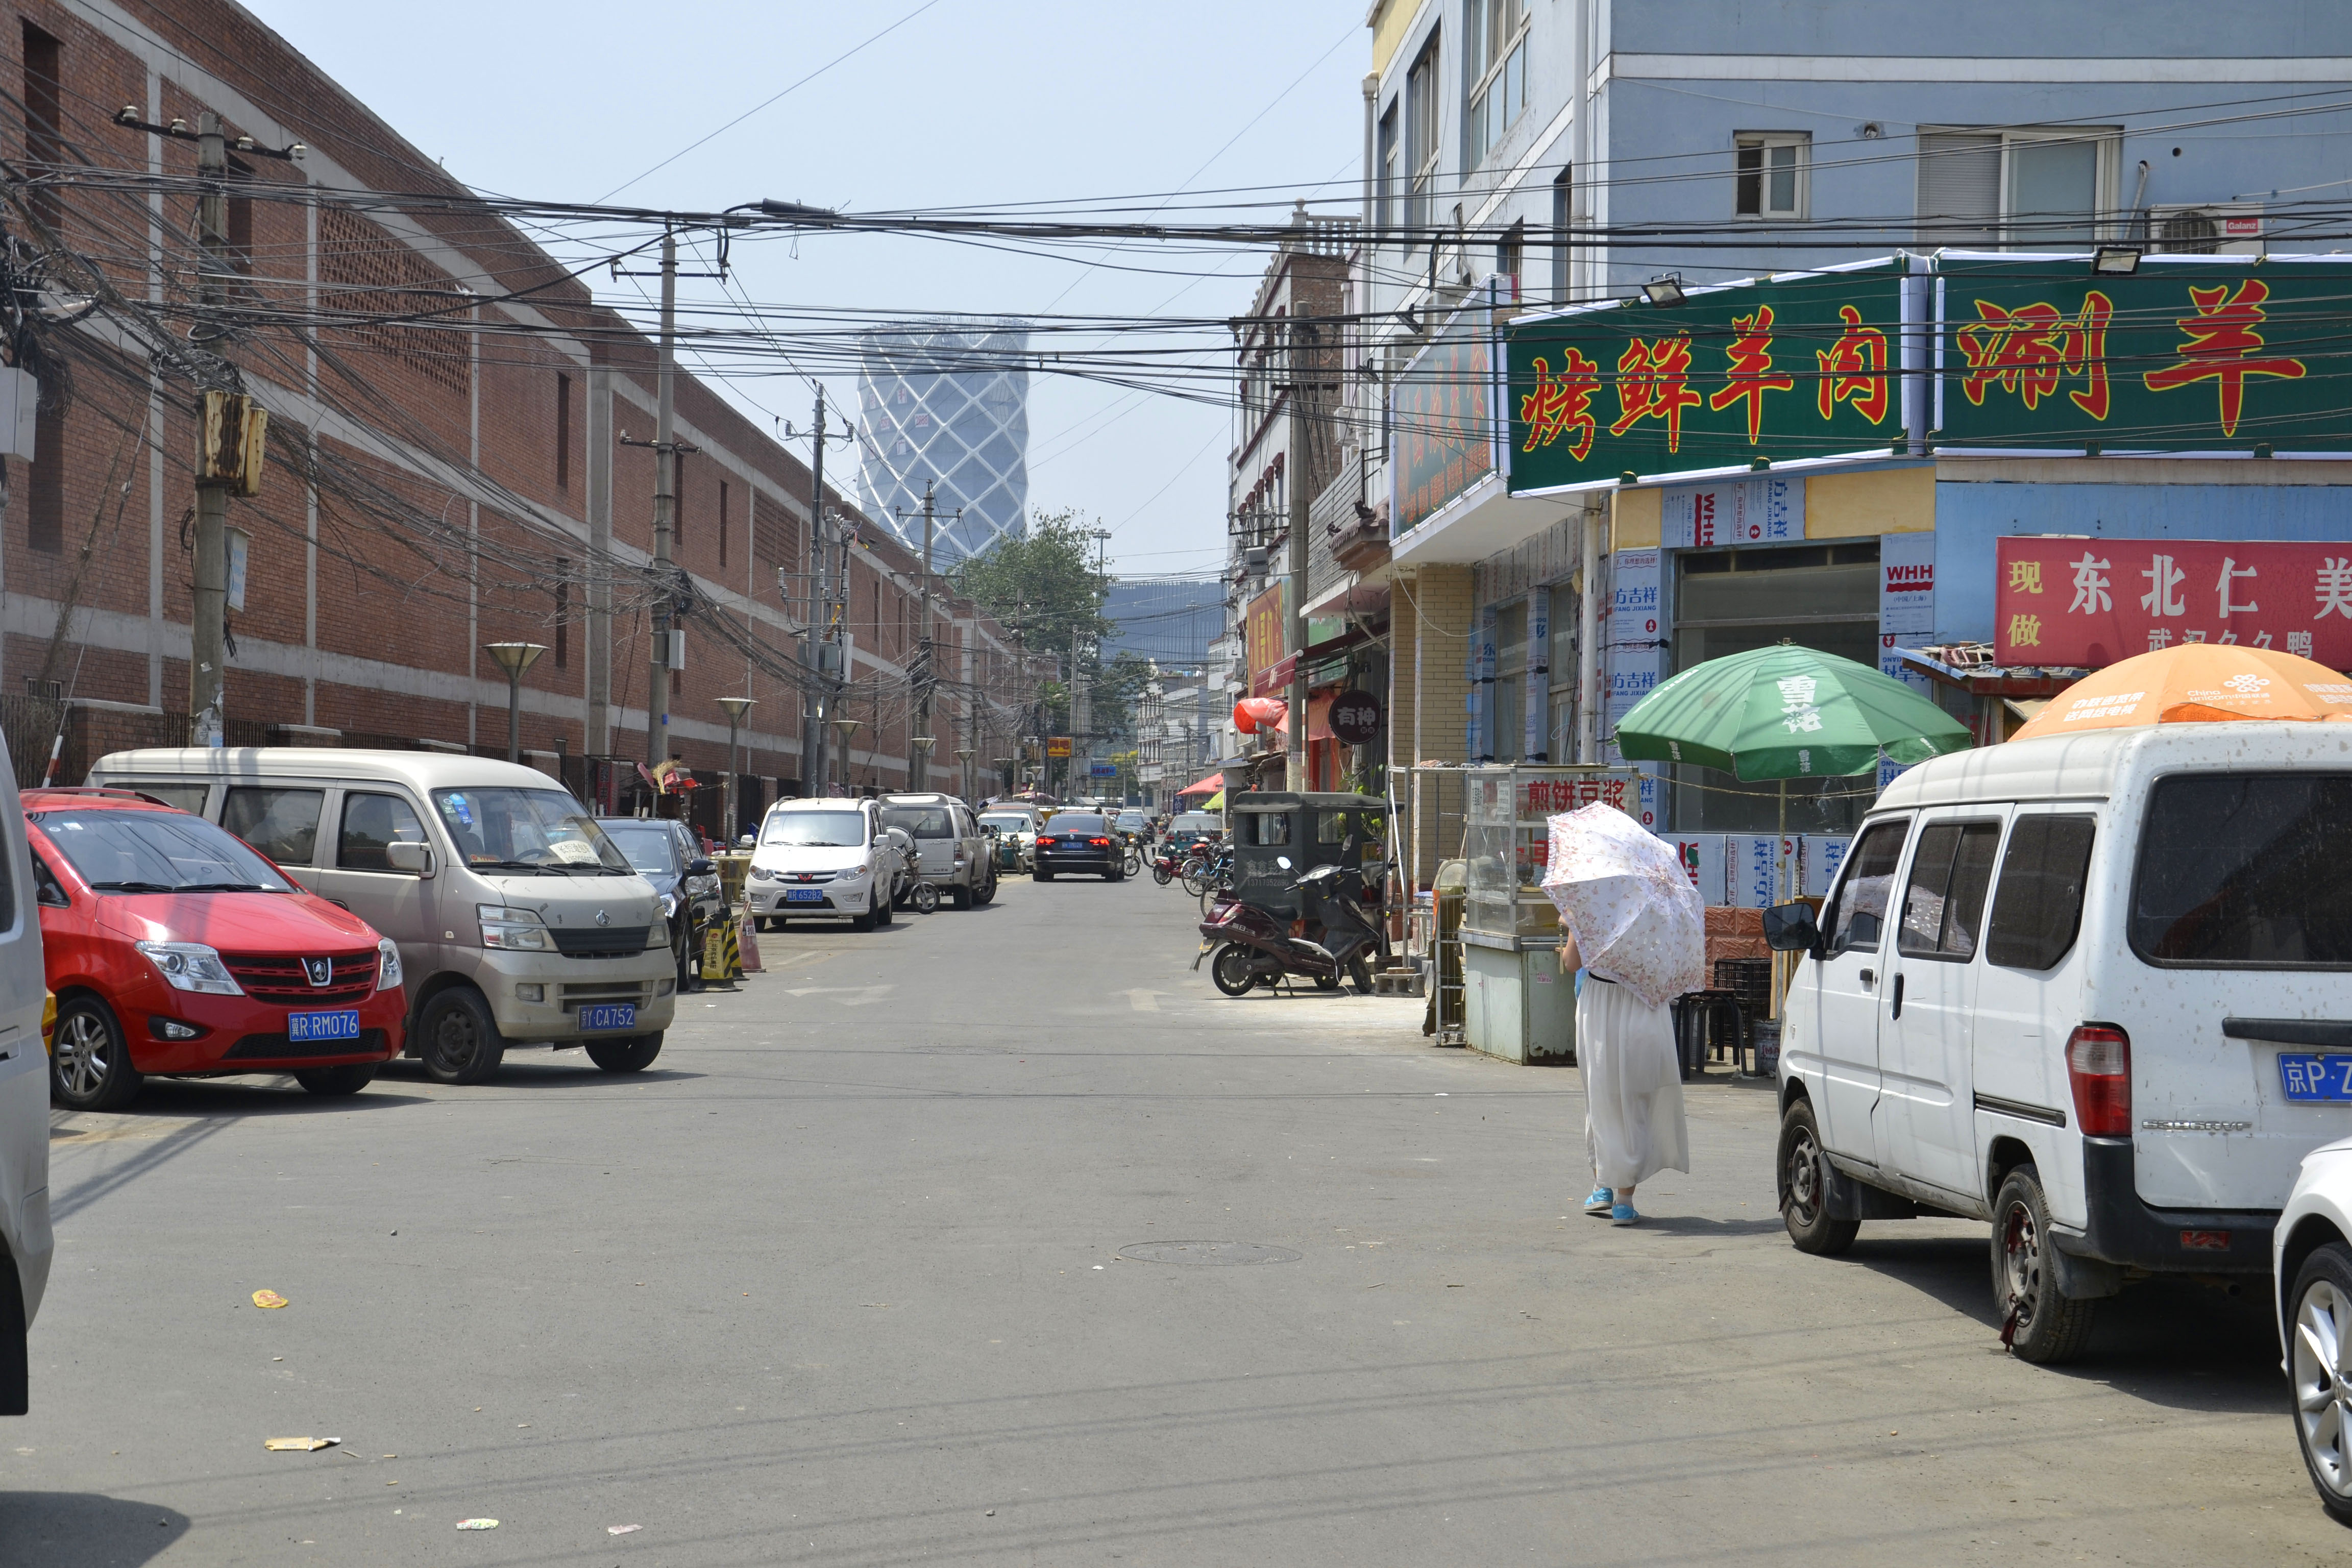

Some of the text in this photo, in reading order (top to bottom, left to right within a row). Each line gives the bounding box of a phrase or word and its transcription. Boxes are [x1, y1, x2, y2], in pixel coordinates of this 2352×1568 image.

[2227, 222, 2257, 230] Galanz
[1956, 279, 2306, 437] 涮羊
[1522, 304, 1888, 462] 烤鲜羊肉
[1886, 564, 1933, 581] WHH
[2008, 560, 2043, 648] 现做
[1776, 675, 1823, 734] 雪花
[2190, 694, 2231, 702] unicom
[1337, 707, 1376, 725] 有神
[2063, 704, 2137, 722] 送网络电视
[1799, 749, 1811, 773] 雪花
[1527, 780, 1626, 812] 煎饼豆浆
[291, 1015, 357, 1037] 冀R·RM076
[582, 1008, 633, 1027] 京Y·CA752
